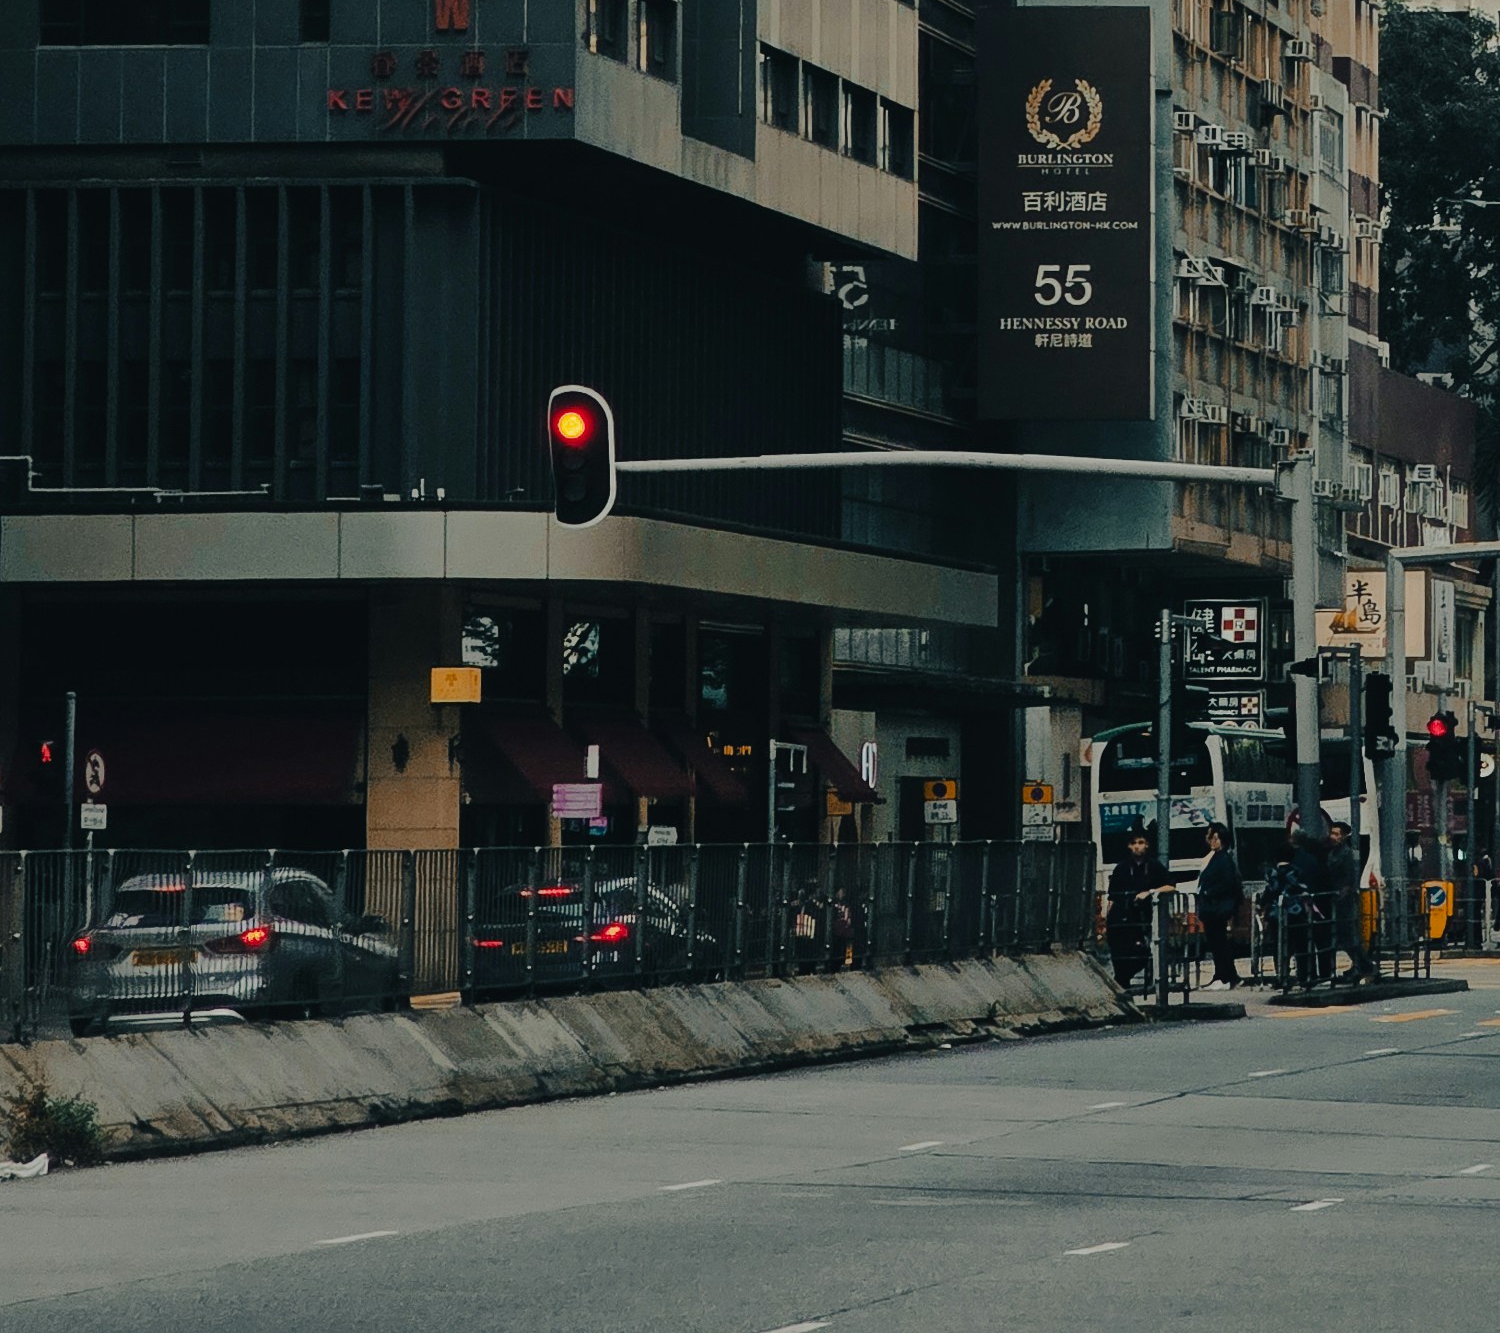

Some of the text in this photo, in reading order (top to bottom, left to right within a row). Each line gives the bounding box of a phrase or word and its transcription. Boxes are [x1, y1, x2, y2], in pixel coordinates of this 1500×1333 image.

[328, 87, 575, 111] KEW GREEN
[1018, 153, 1114, 165] BURLINGTON
[1021, 190, 1108, 213] 百利酒店
[1034, 264, 1092, 306] 55
[1000, 317, 1128, 329] HENNESSY ROAD
[1034, 334, 1093, 348] 軒尼詩道
[1347, 579, 1382, 625] 半島
[1217, 666, 1257, 674] PHARMACY
